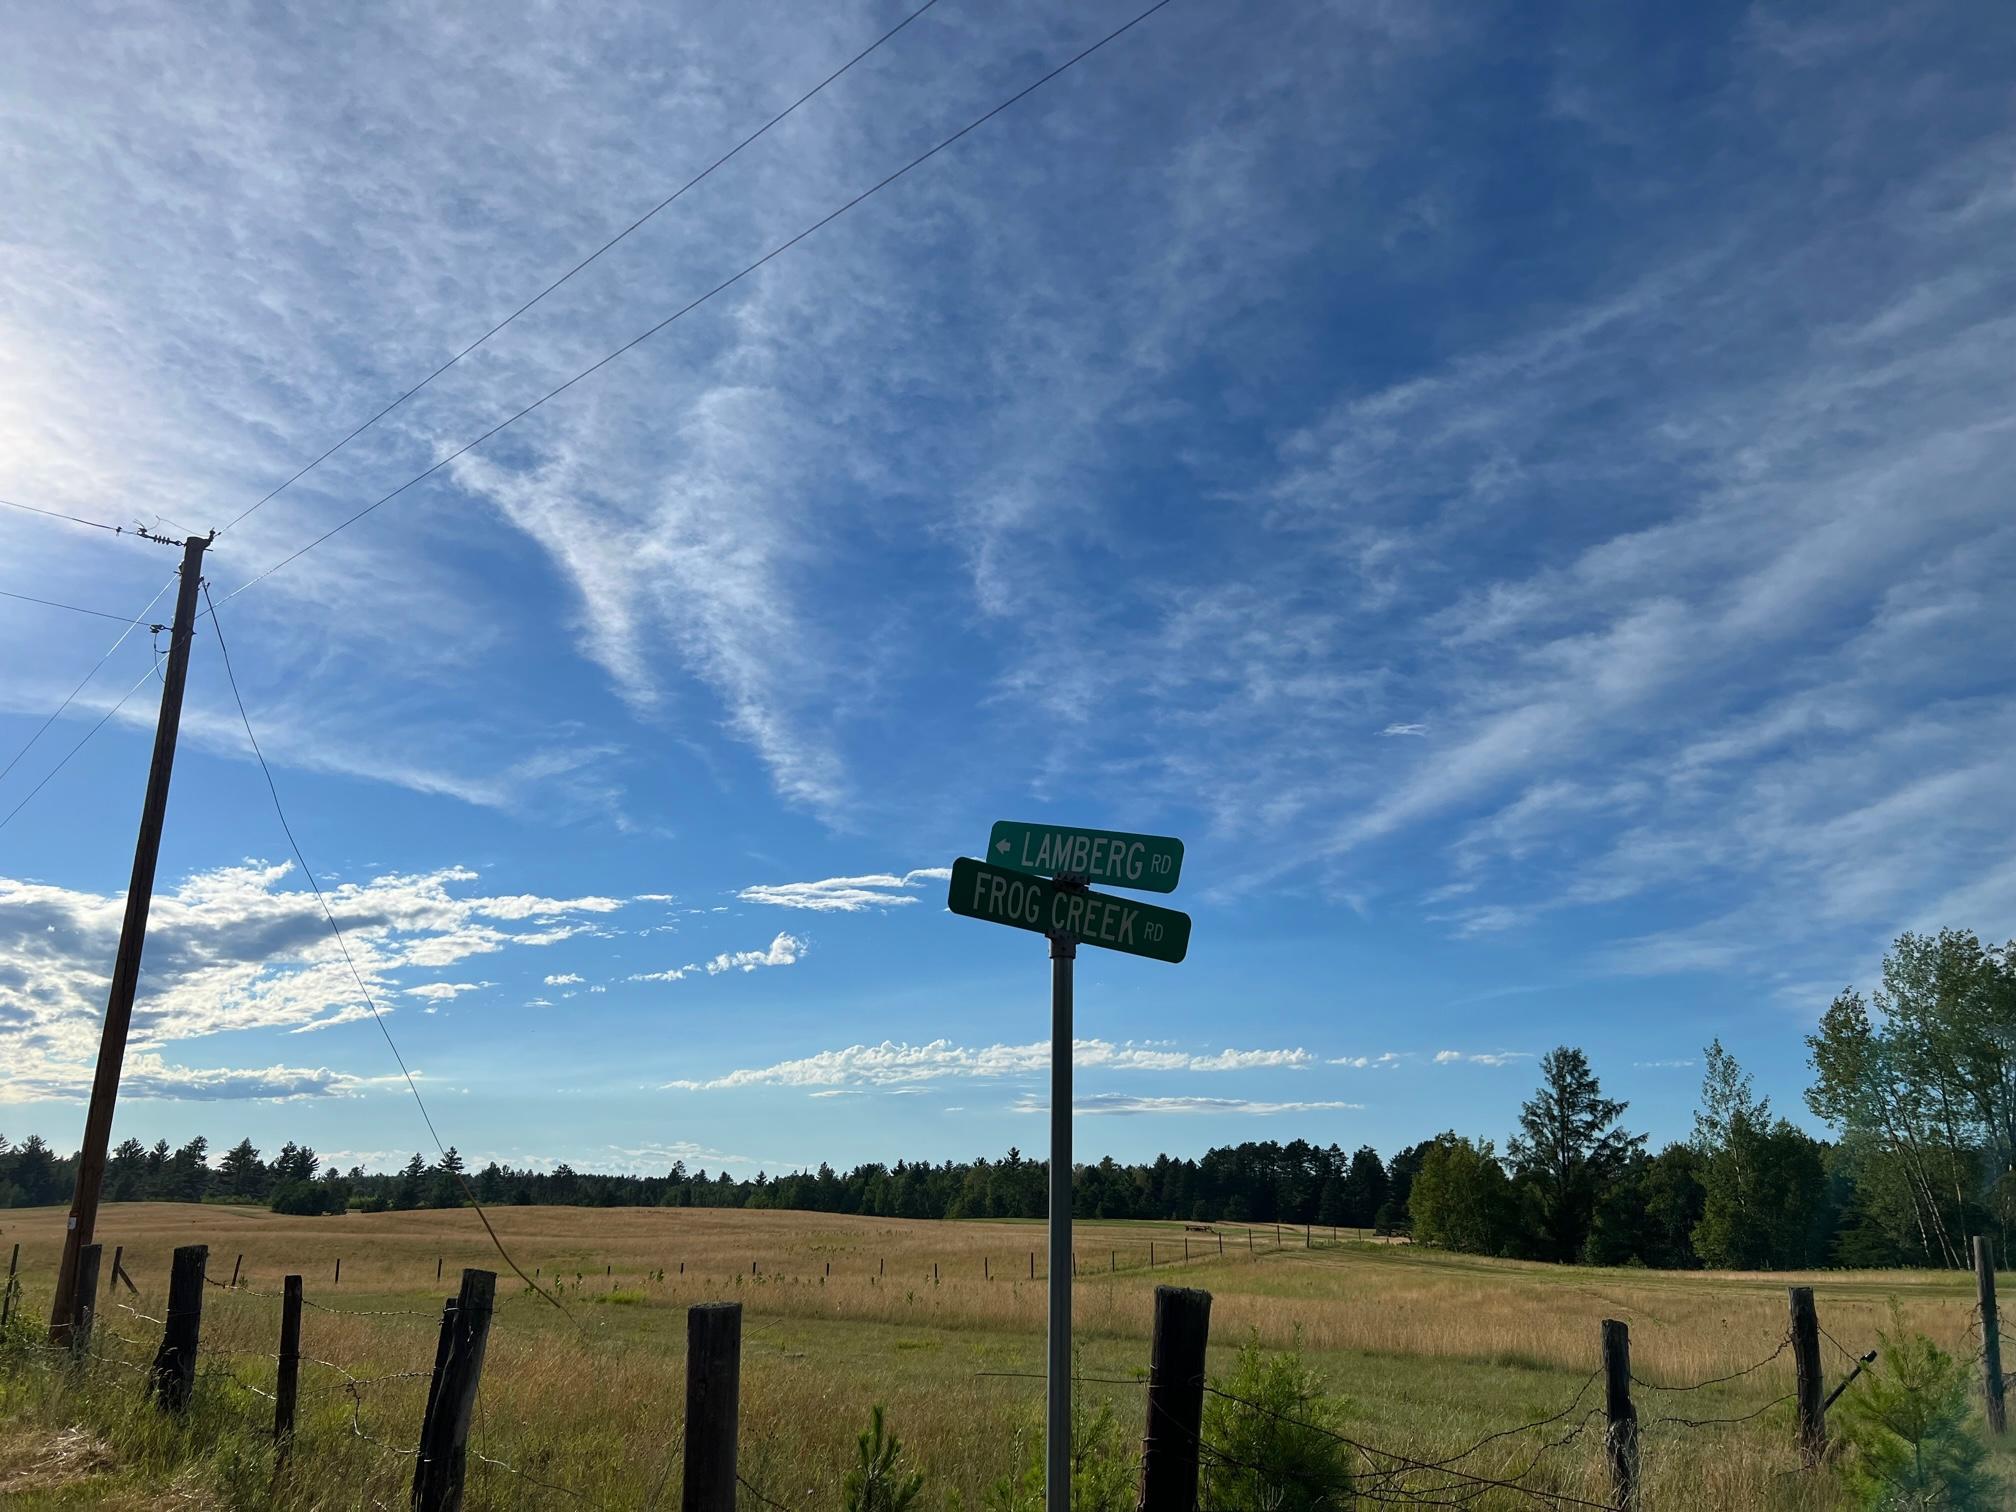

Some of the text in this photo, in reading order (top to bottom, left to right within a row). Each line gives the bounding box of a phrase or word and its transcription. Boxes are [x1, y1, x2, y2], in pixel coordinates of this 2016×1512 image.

[1021, 831, 1172, 880] LAMBERG RD
[973, 871, 1164, 945] FROG CREEK RD
